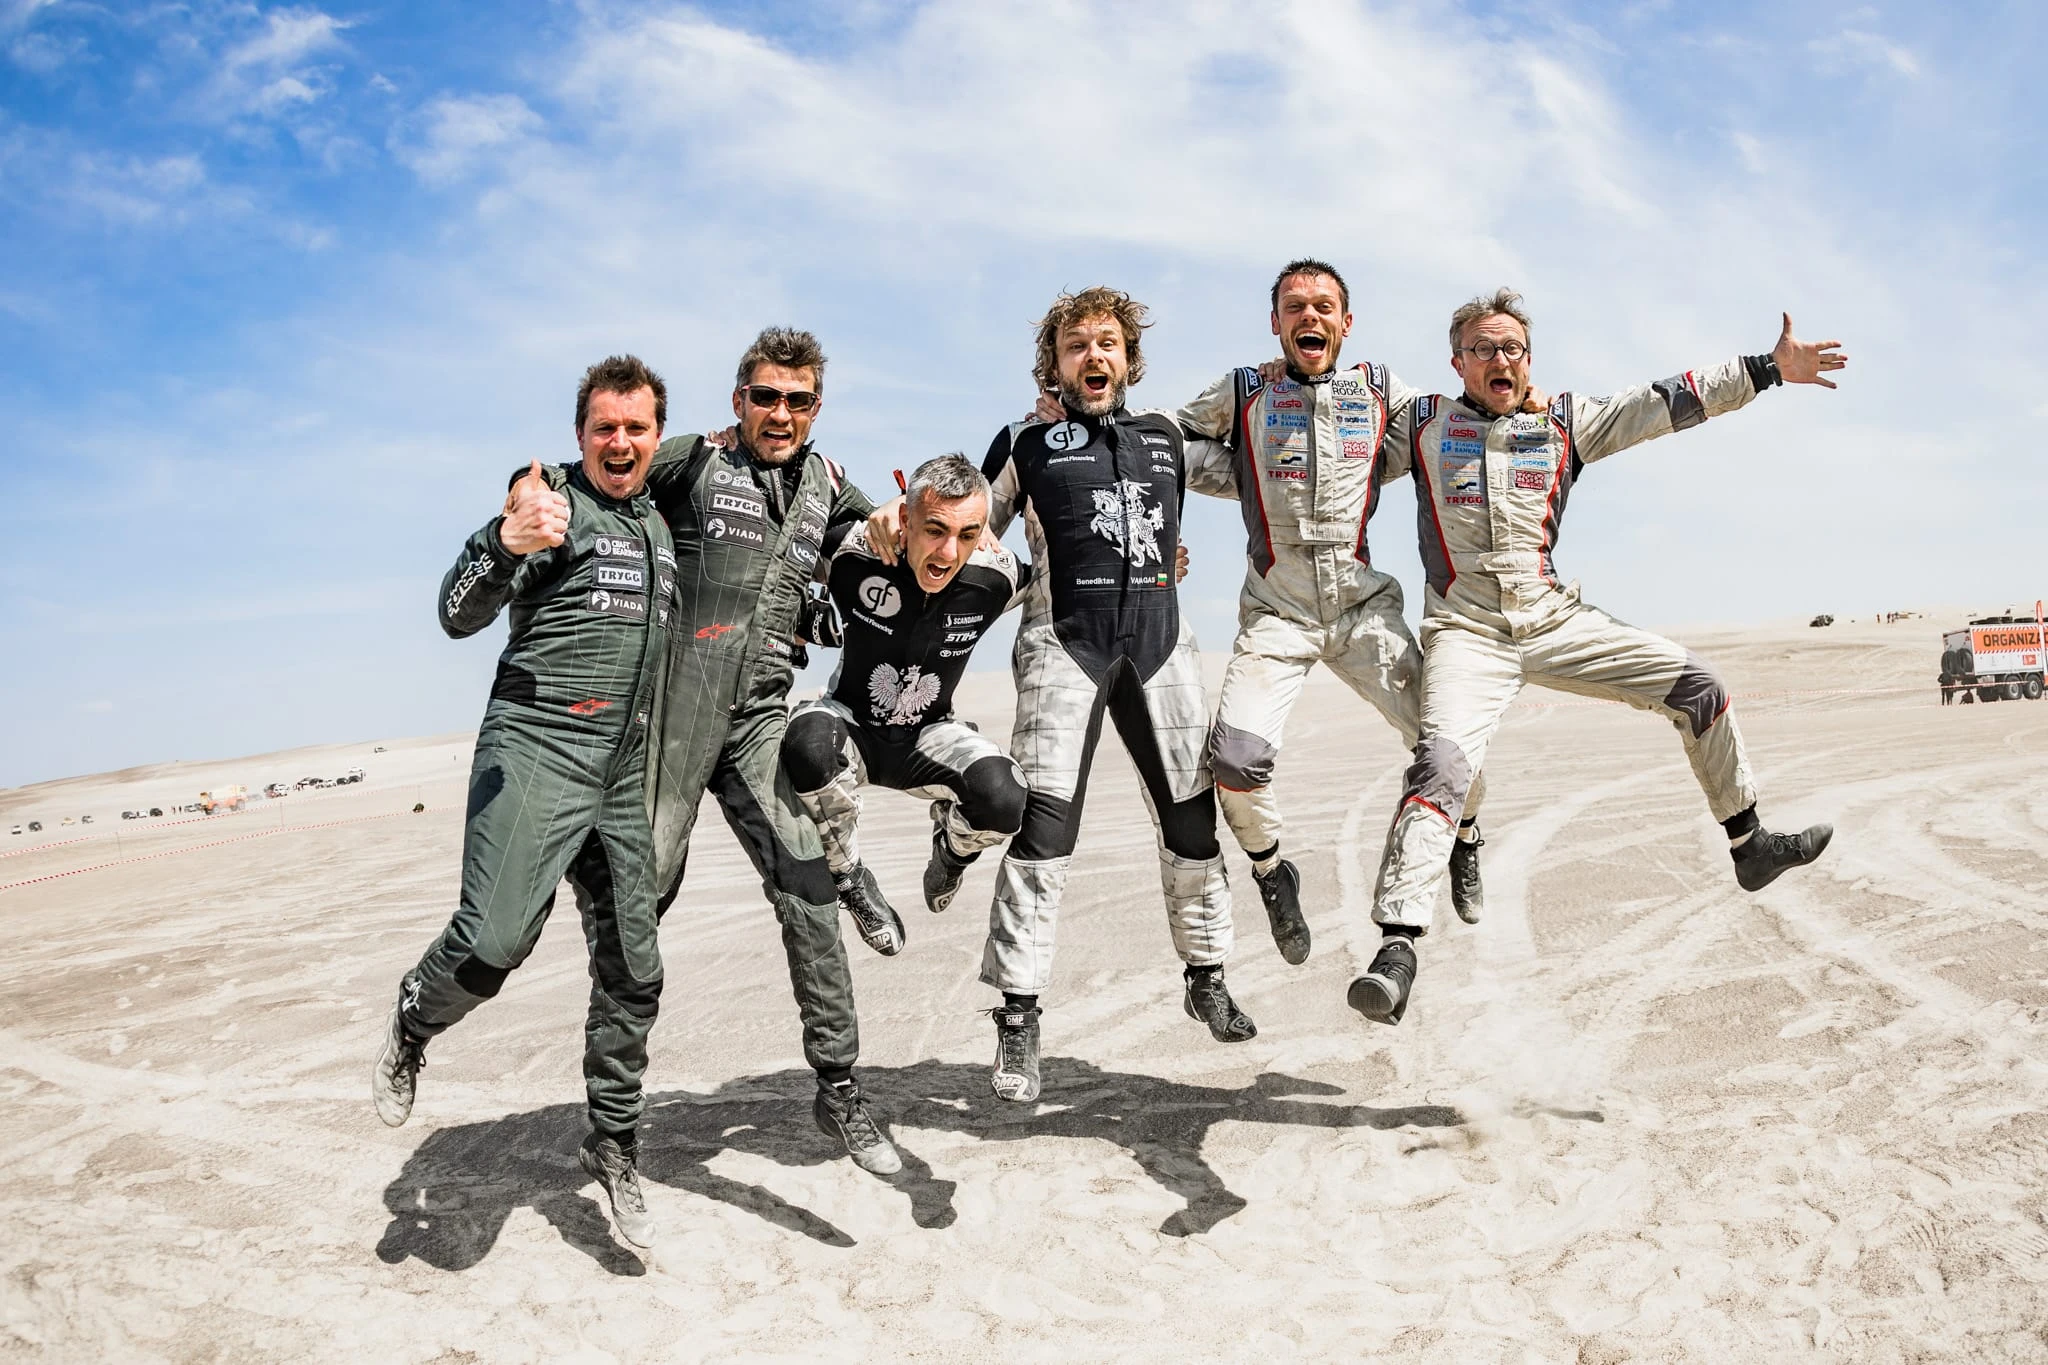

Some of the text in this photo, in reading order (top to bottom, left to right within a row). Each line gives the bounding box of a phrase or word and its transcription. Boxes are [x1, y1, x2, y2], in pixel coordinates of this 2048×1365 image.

[1332, 379, 1359, 389] AGRO
[1332, 387, 1366, 396] RODEO
[1272, 398, 1303, 409] Lesta
[1448, 427, 1477, 438] Lesta
[1268, 470, 1307, 479] TRYGG
[715, 496, 761, 514] TRYGG
[1445, 496, 1483, 504] TRYGG
[728, 526, 763, 543] VIADA
[612, 548, 644, 559] BEARINGS
[998, 556, 1009, 564] 21
[600, 570, 640, 583] TRYGG
[1076, 577, 1115, 586] Benediktas
[612, 598, 643, 612] VIADA
[1006, 1015, 1024, 1025] OMP
